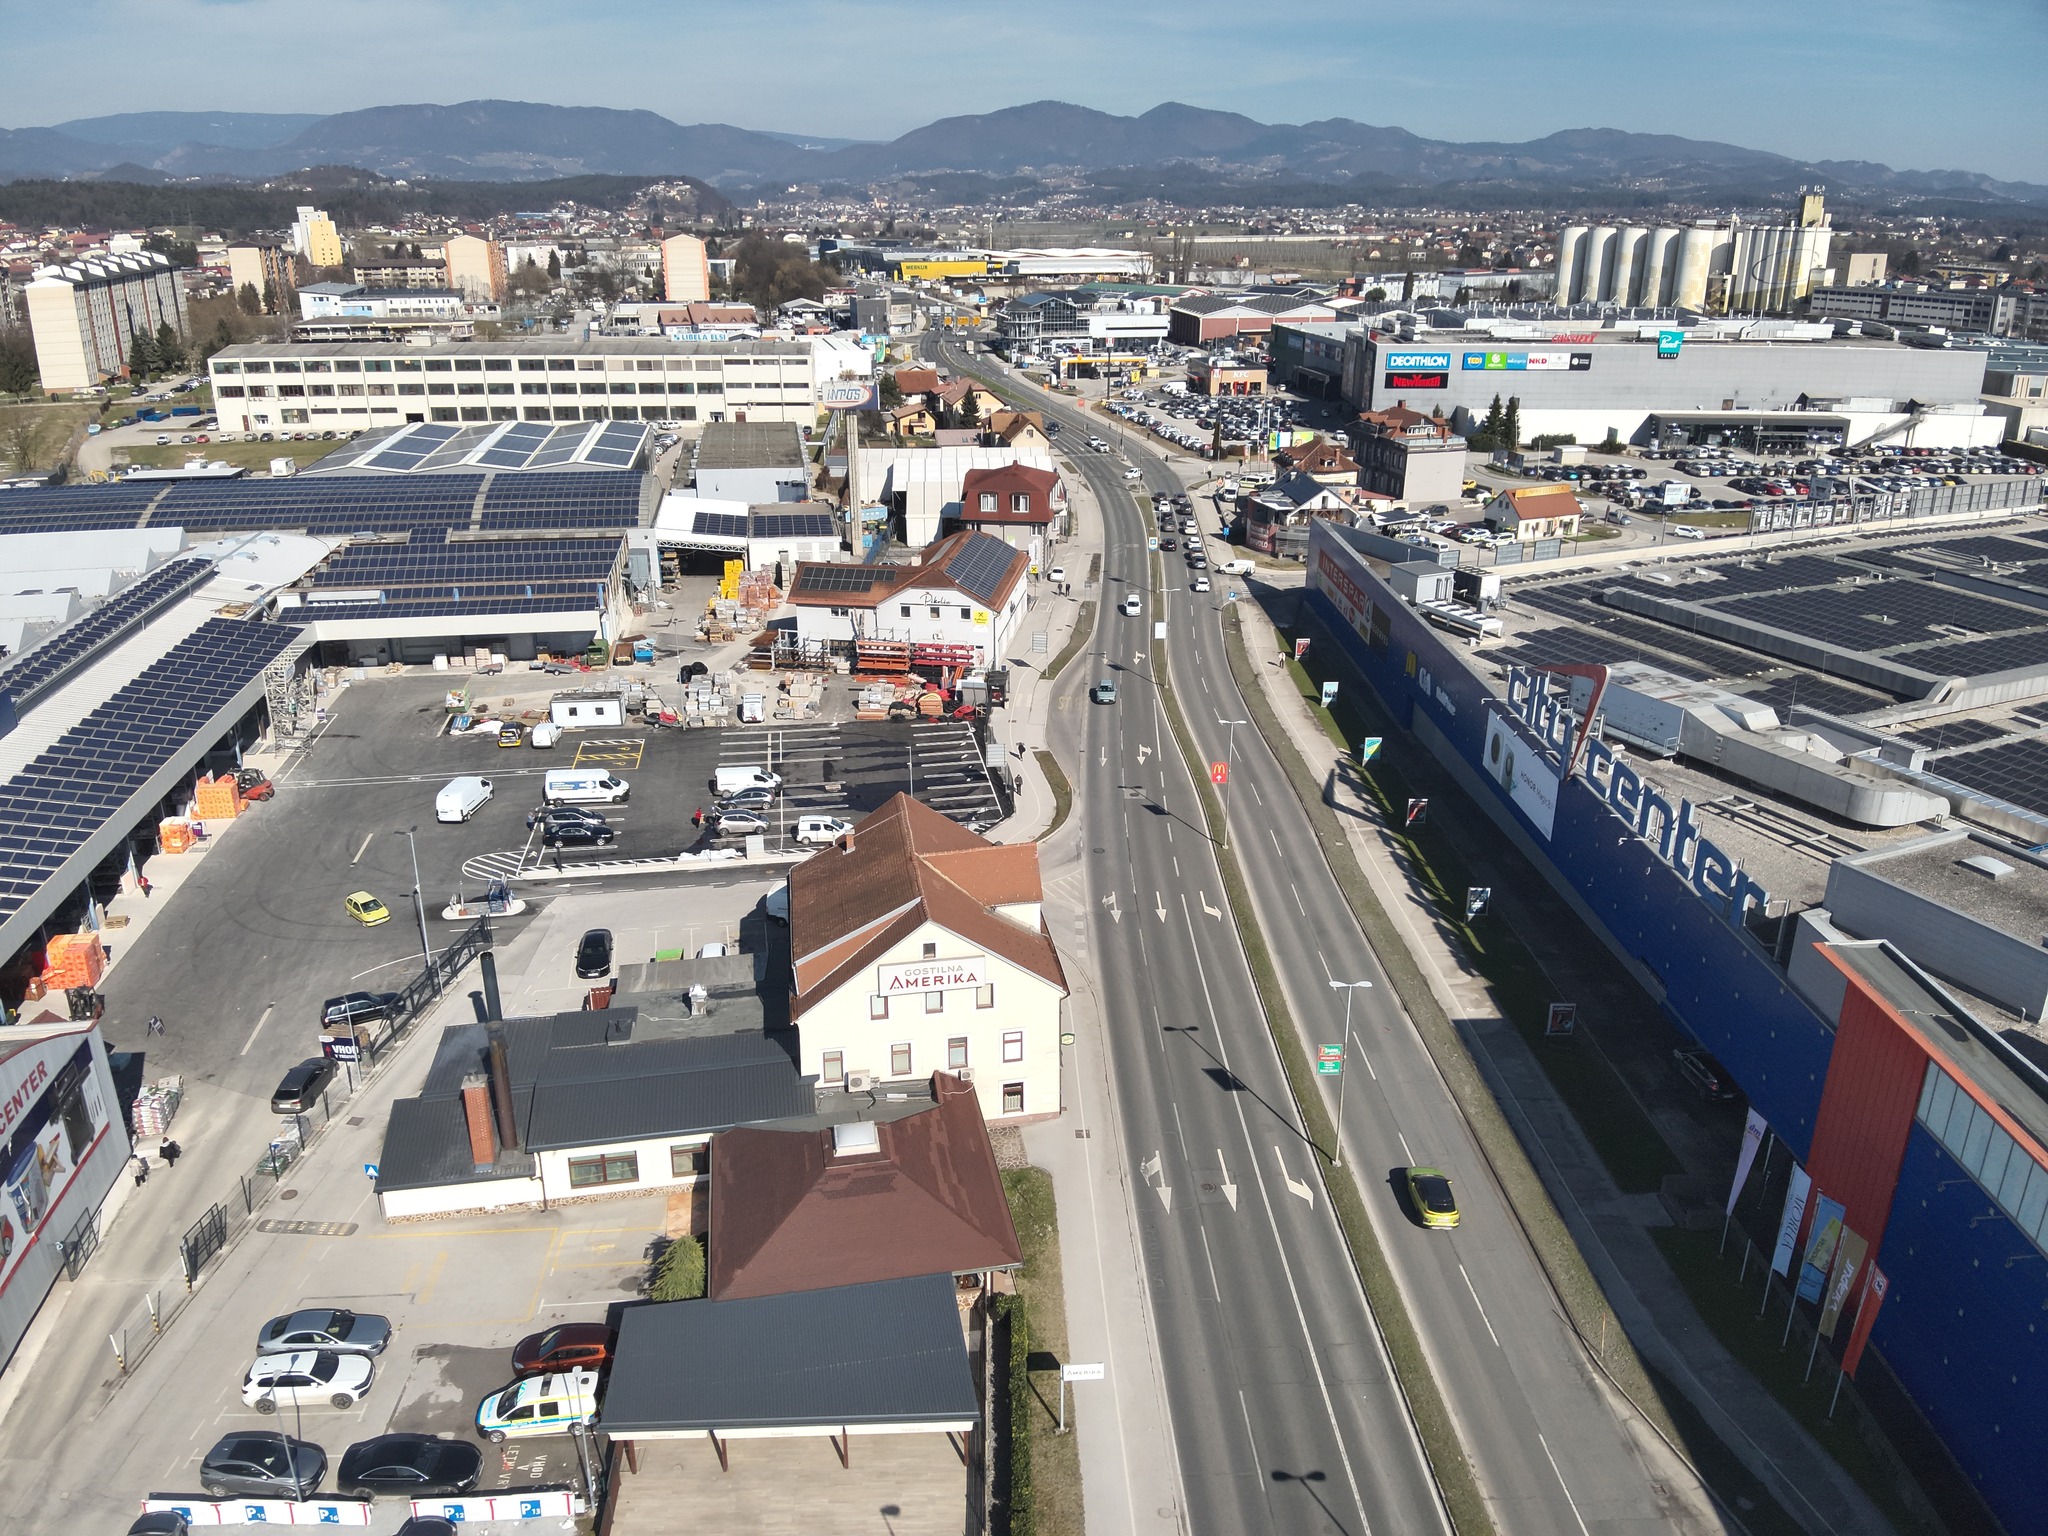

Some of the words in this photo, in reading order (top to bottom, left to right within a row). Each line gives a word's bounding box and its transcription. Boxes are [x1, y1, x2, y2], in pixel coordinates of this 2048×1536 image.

[1390, 355, 1448, 367] DECATHLON
[1321, 554, 1367, 613] INTERSPAR
[1508, 666, 1577, 780] city
[1585, 734, 1770, 932] center
[904, 965, 963, 977] GOSTILNA
[889, 972, 977, 990] AMERIKA
[1749, 1124, 1761, 1137] dm
[529, 1454, 548, 1479] VHOD
